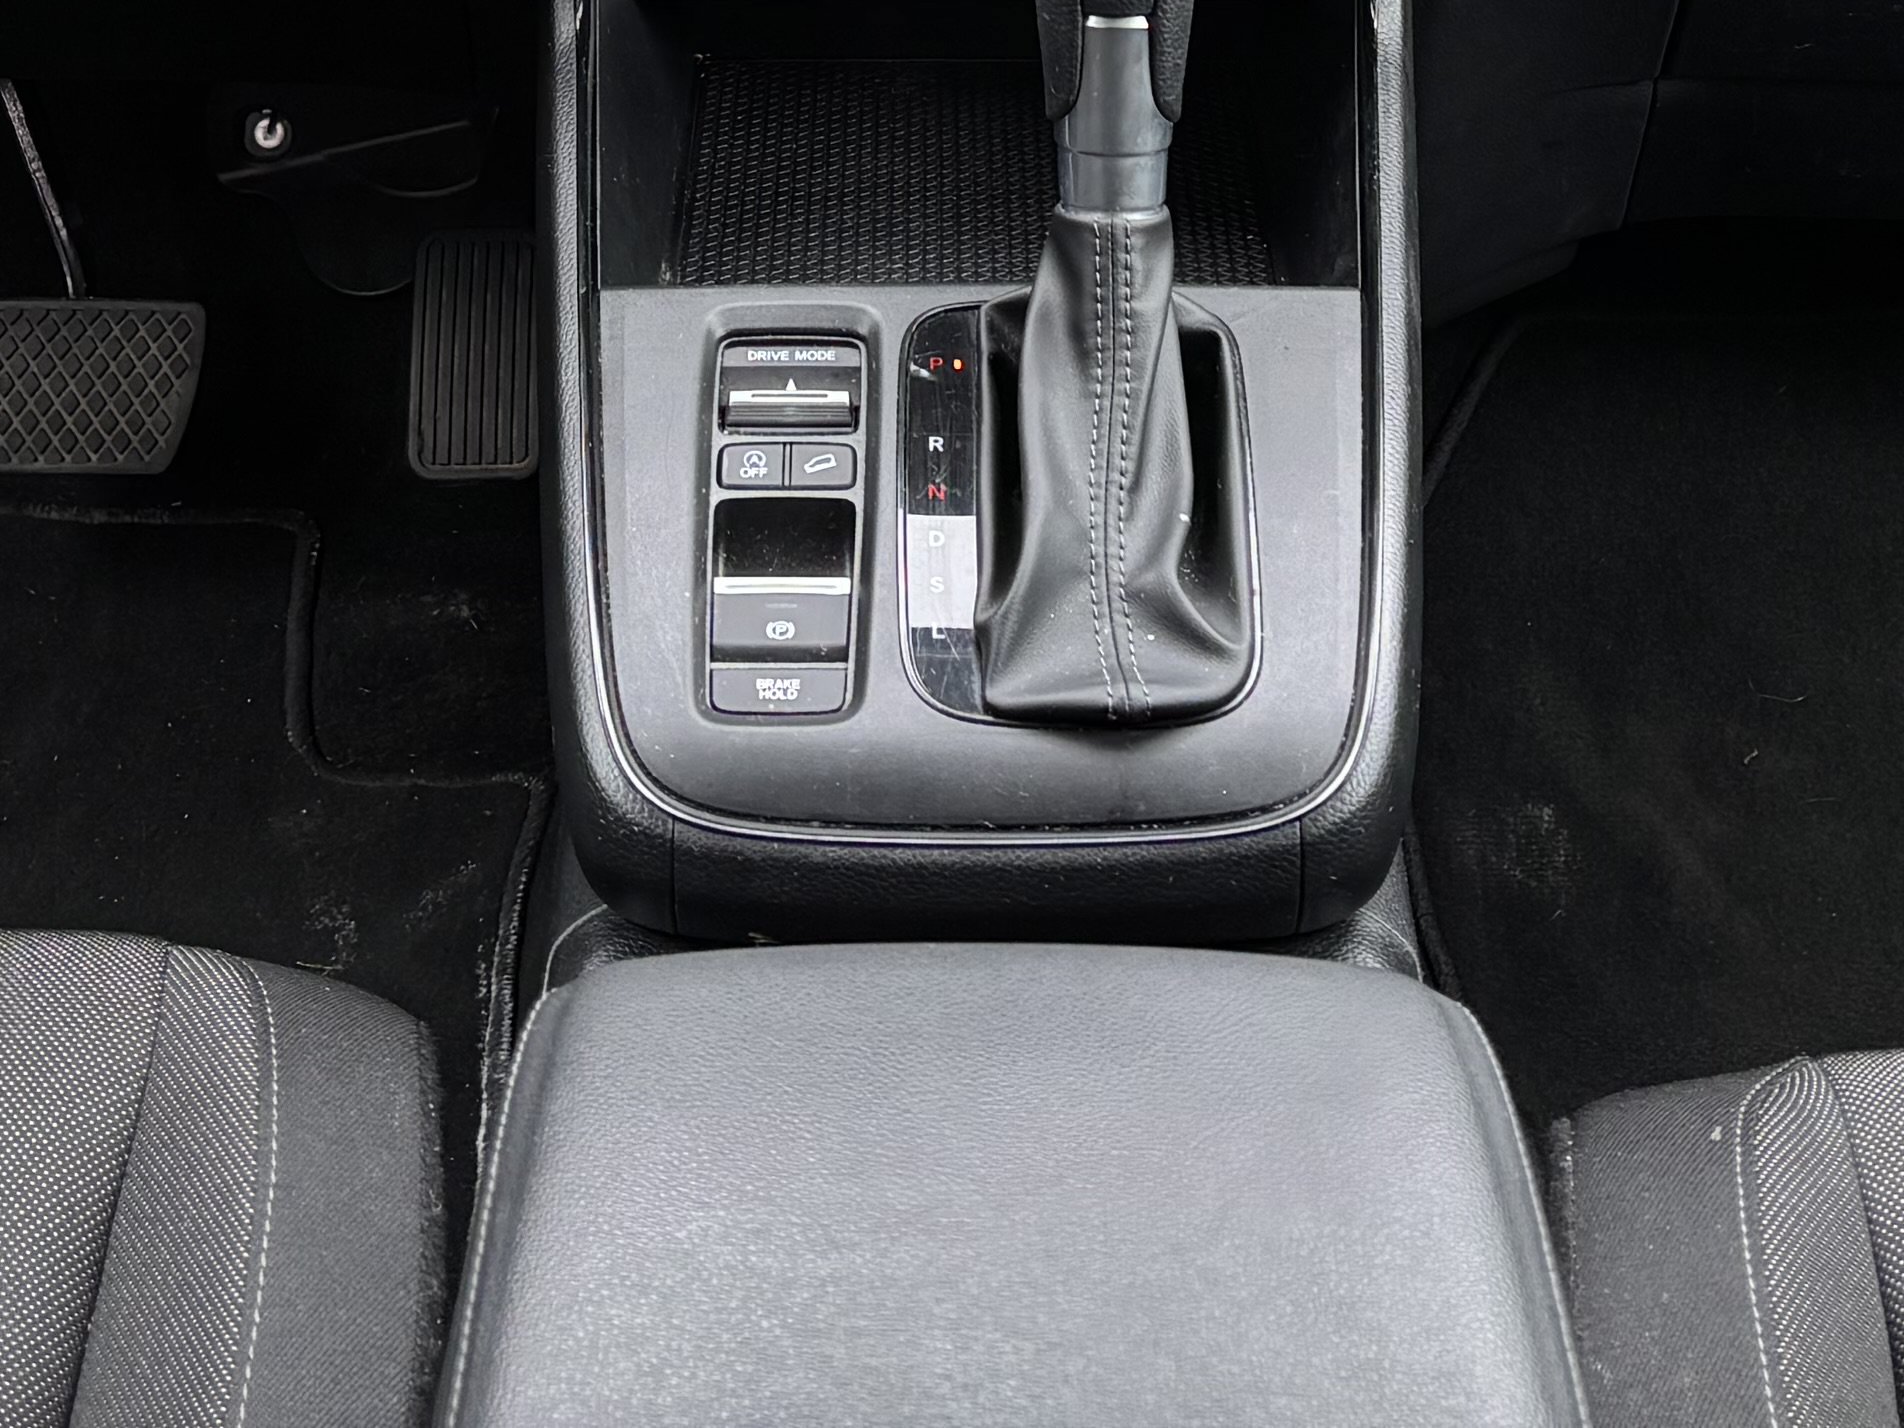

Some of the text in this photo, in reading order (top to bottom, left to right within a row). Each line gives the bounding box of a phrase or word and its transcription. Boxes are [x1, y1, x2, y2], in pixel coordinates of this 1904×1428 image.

[747, 350, 836, 362] DRIVE MODE
[929, 356, 944, 371] P
[928, 436, 945, 452] R
[739, 466, 769, 479] OFF
[928, 484, 945, 500] N
[929, 531, 945, 548] D
[929, 576, 945, 593] S
[931, 623, 946, 640] L
[755, 678, 801, 691] BRAKE
[758, 689, 799, 701] HOLD
